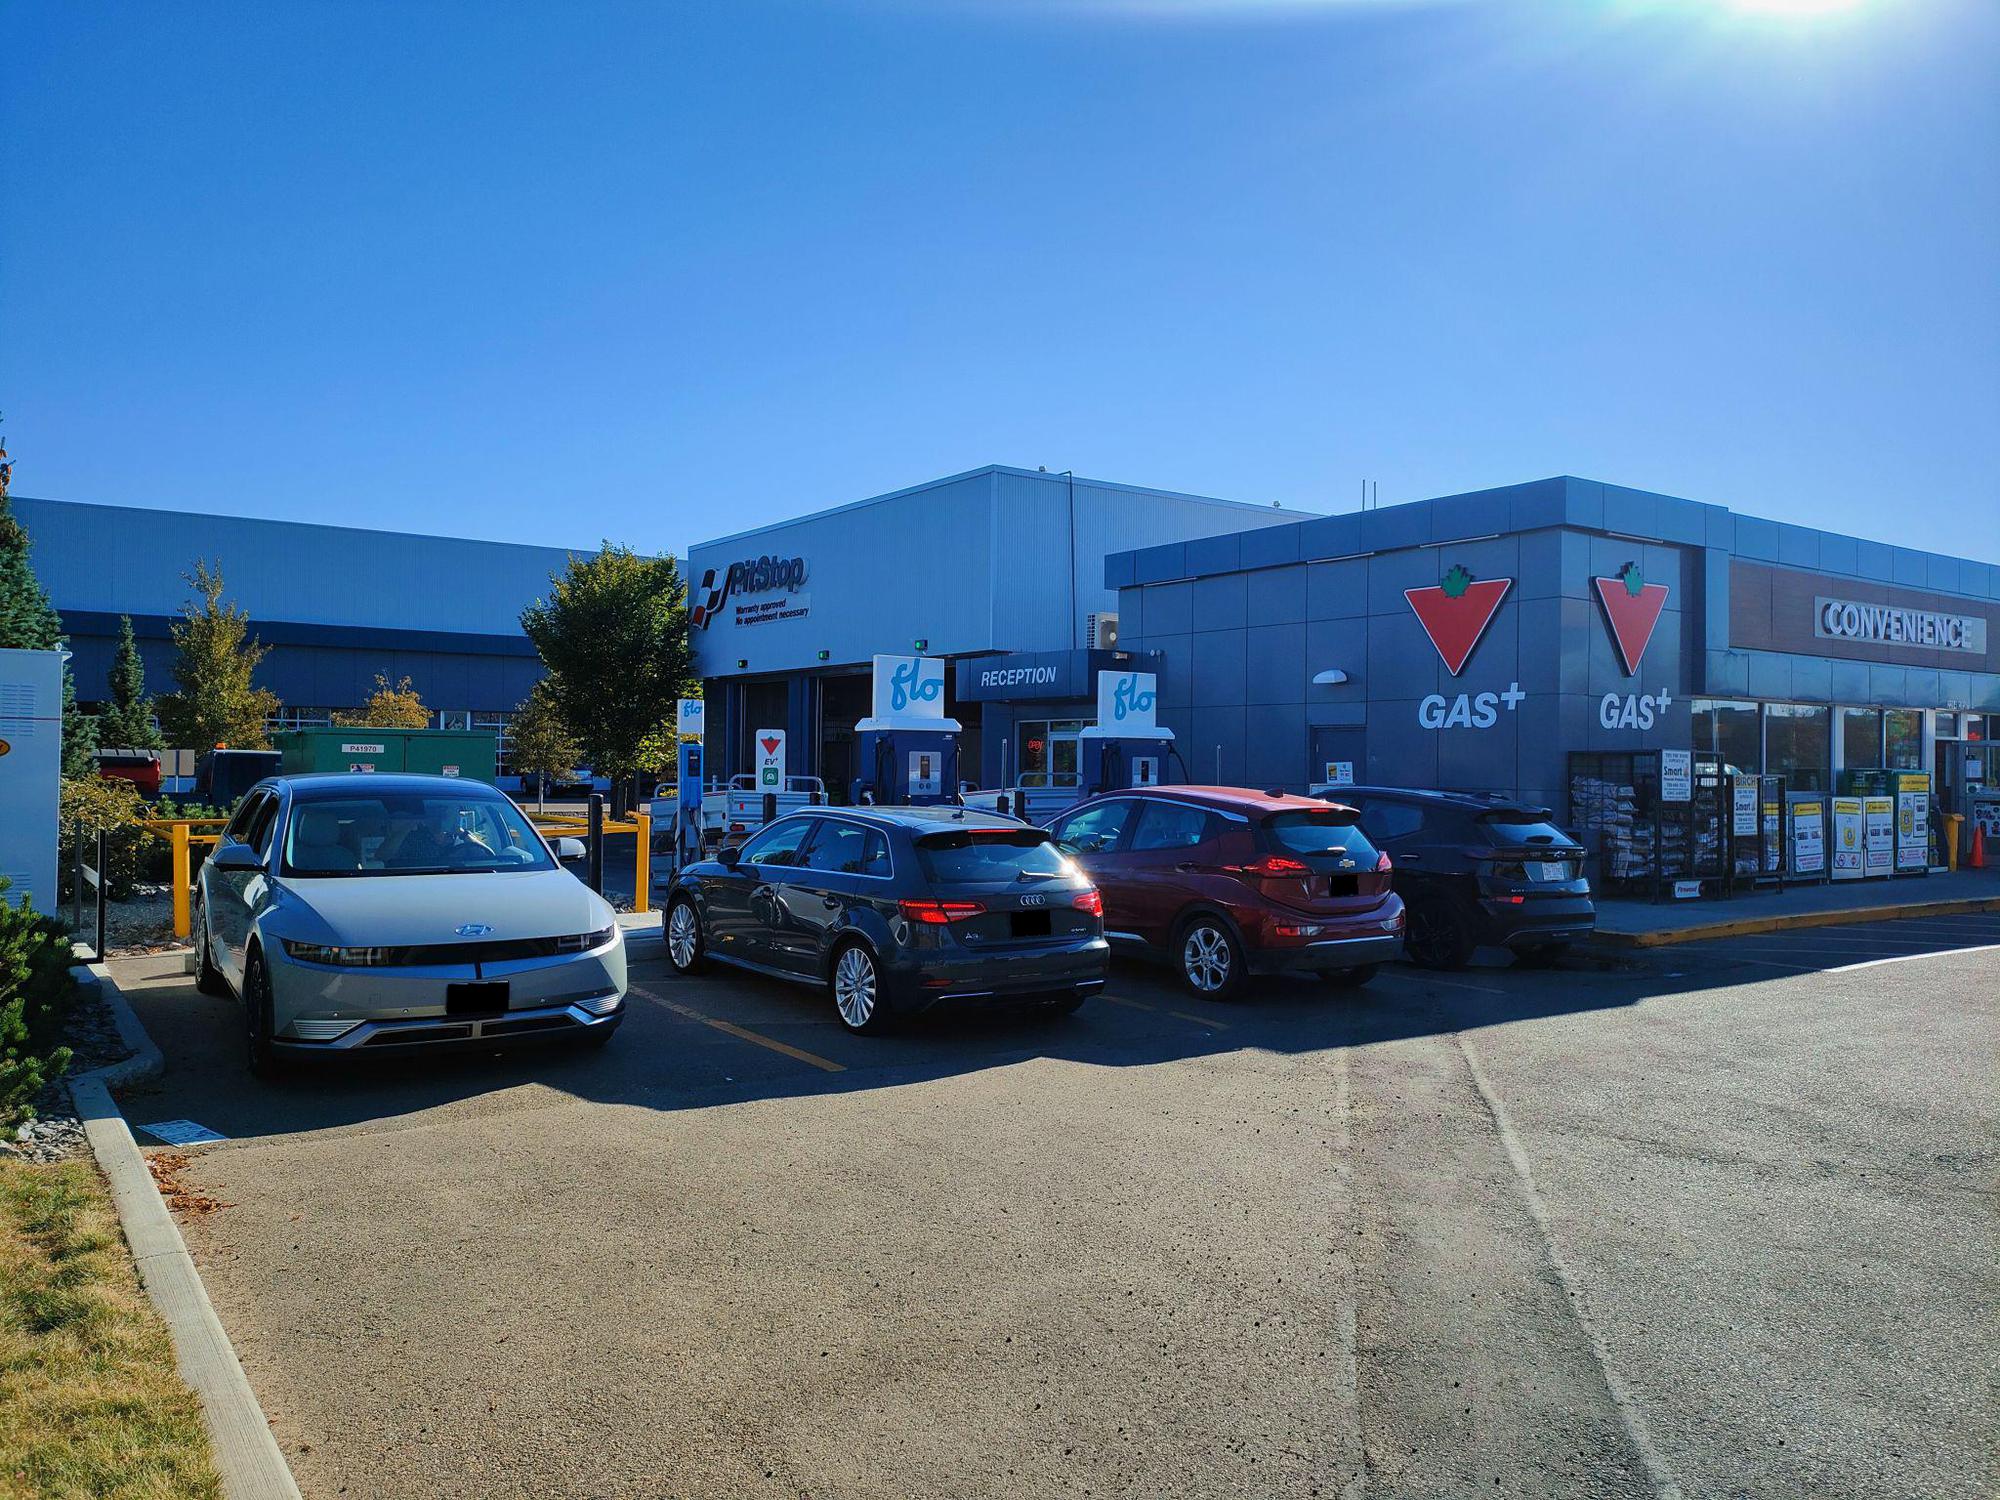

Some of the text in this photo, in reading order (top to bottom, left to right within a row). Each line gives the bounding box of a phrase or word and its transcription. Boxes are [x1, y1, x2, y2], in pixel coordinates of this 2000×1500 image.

[729, 556, 806, 596] PitStop
[760, 599, 787, 611] approved
[744, 611, 778, 625] appointment
[779, 608, 810, 619] necessary
[1826, 602, 1974, 648] CONVENIENCE
[891, 658, 944, 711] flo
[981, 667, 1057, 687] RECEPTION
[1114, 674, 1157, 721] flo
[683, 700, 703, 717] flo
[1663, 766, 1683, 776] Smart
[1735, 776, 1756, 787] BIRCH
[1735, 802, 1751, 811] Smart
